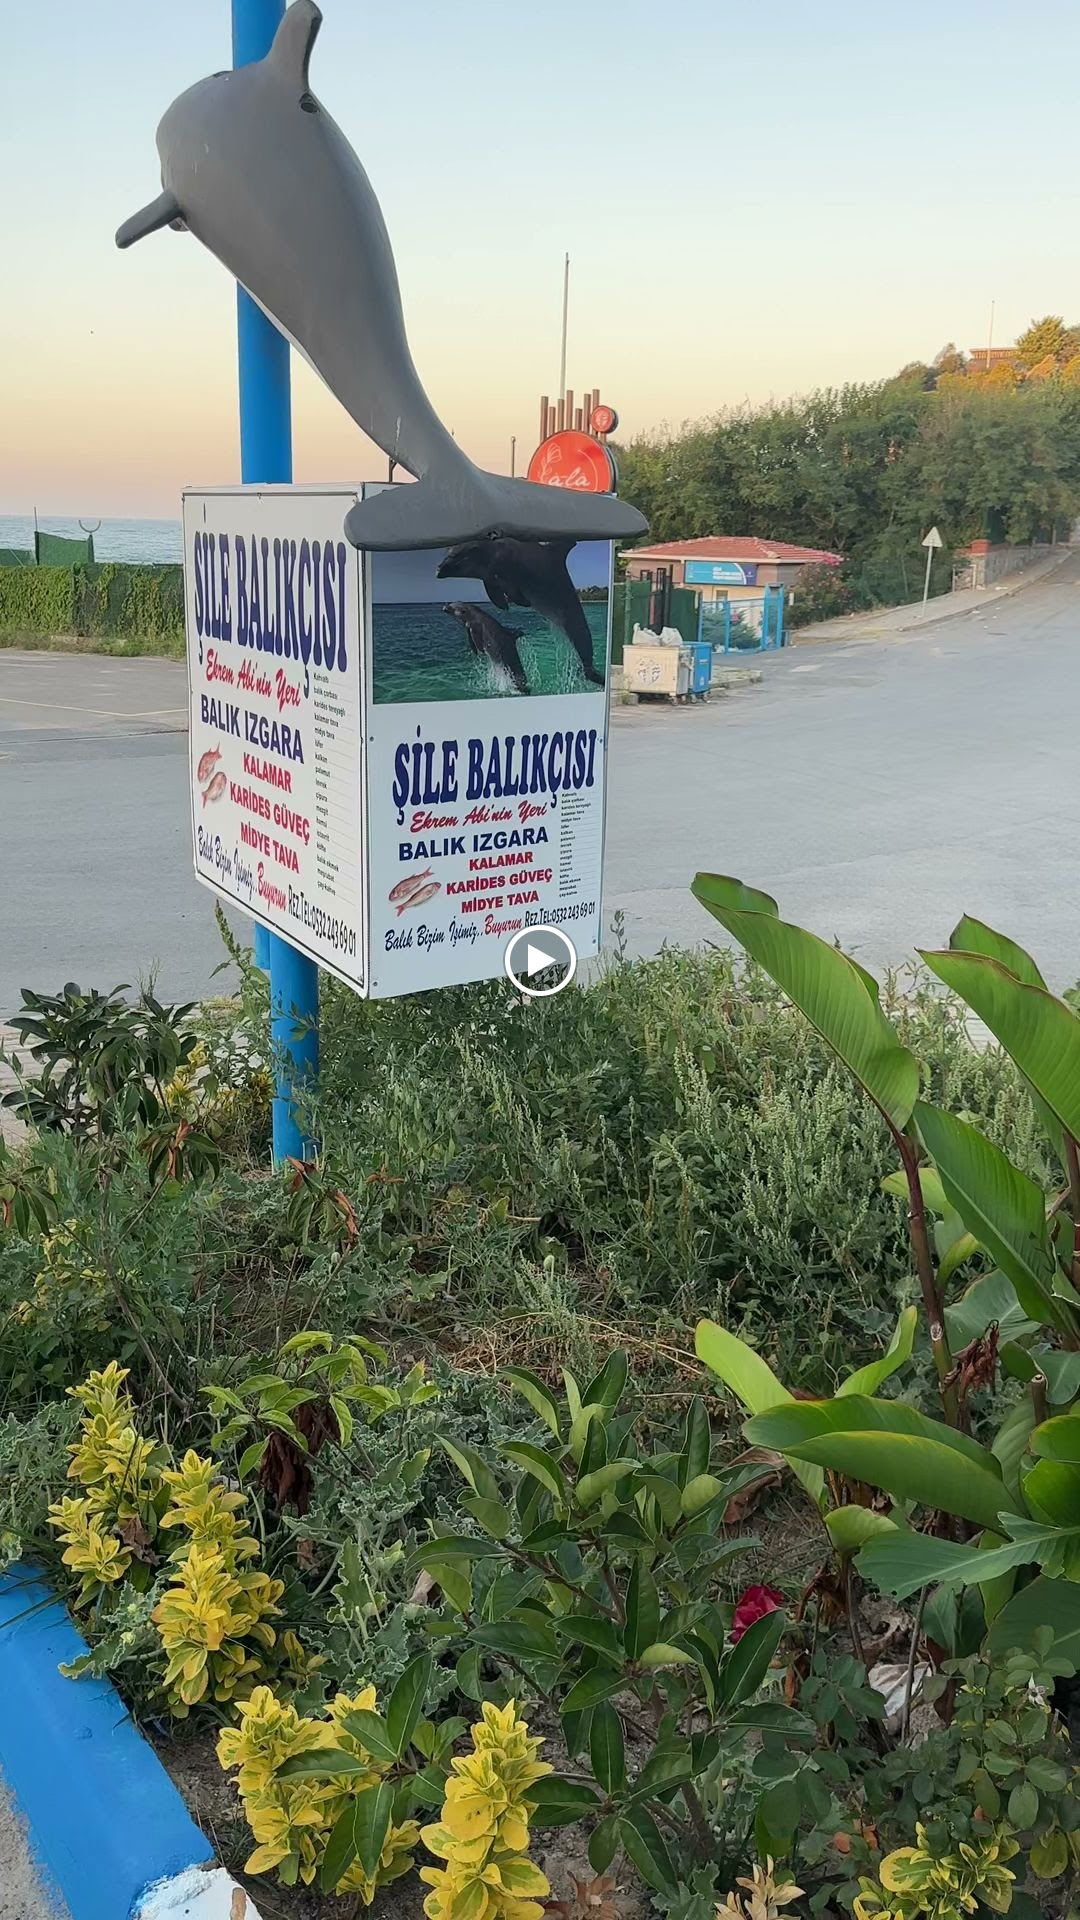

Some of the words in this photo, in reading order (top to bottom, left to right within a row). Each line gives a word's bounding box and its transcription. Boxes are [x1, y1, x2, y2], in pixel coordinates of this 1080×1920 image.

[194, 503, 232, 665] ŞİLE
[235, 534, 347, 699] BALIKÇISI
[206, 648, 234, 685] Ekrem
[237, 658, 272, 698] Abi'nin
[275, 667, 301, 713] Yeri
[201, 693, 241, 738] BALIK
[244, 710, 304, 764] IZGARA
[243, 752, 292, 793] KALAMAR
[392, 724, 459, 826] ŞİLE
[465, 729, 597, 809] BALIKÇISI
[230, 781, 271, 820] KARİDES
[273, 802, 310, 846] GÜVEÇ
[410, 810, 459, 834] Ekrem
[463, 804, 513, 827] Abi'nin
[516, 800, 548, 825] Yeri
[240, 820, 271, 858] MİDYE
[272, 839, 300, 875] TAVA
[399, 836, 466, 861] BALIK
[473, 827, 549, 853] IZGARA
[469, 851, 534, 872] KALAMAR
[214, 835, 233, 883] Bizim
[257, 861, 287, 913] Buyurun
[446, 875, 507, 896] KARİDES
[509, 868, 553, 890] GÜVEÇ
[461, 896, 504, 914] MİDYE
[507, 890, 540, 906] TAVA
[384, 927, 414, 952] Balık
[416, 923, 445, 953] Bizim
[484, 913, 523, 939] Buyurun
